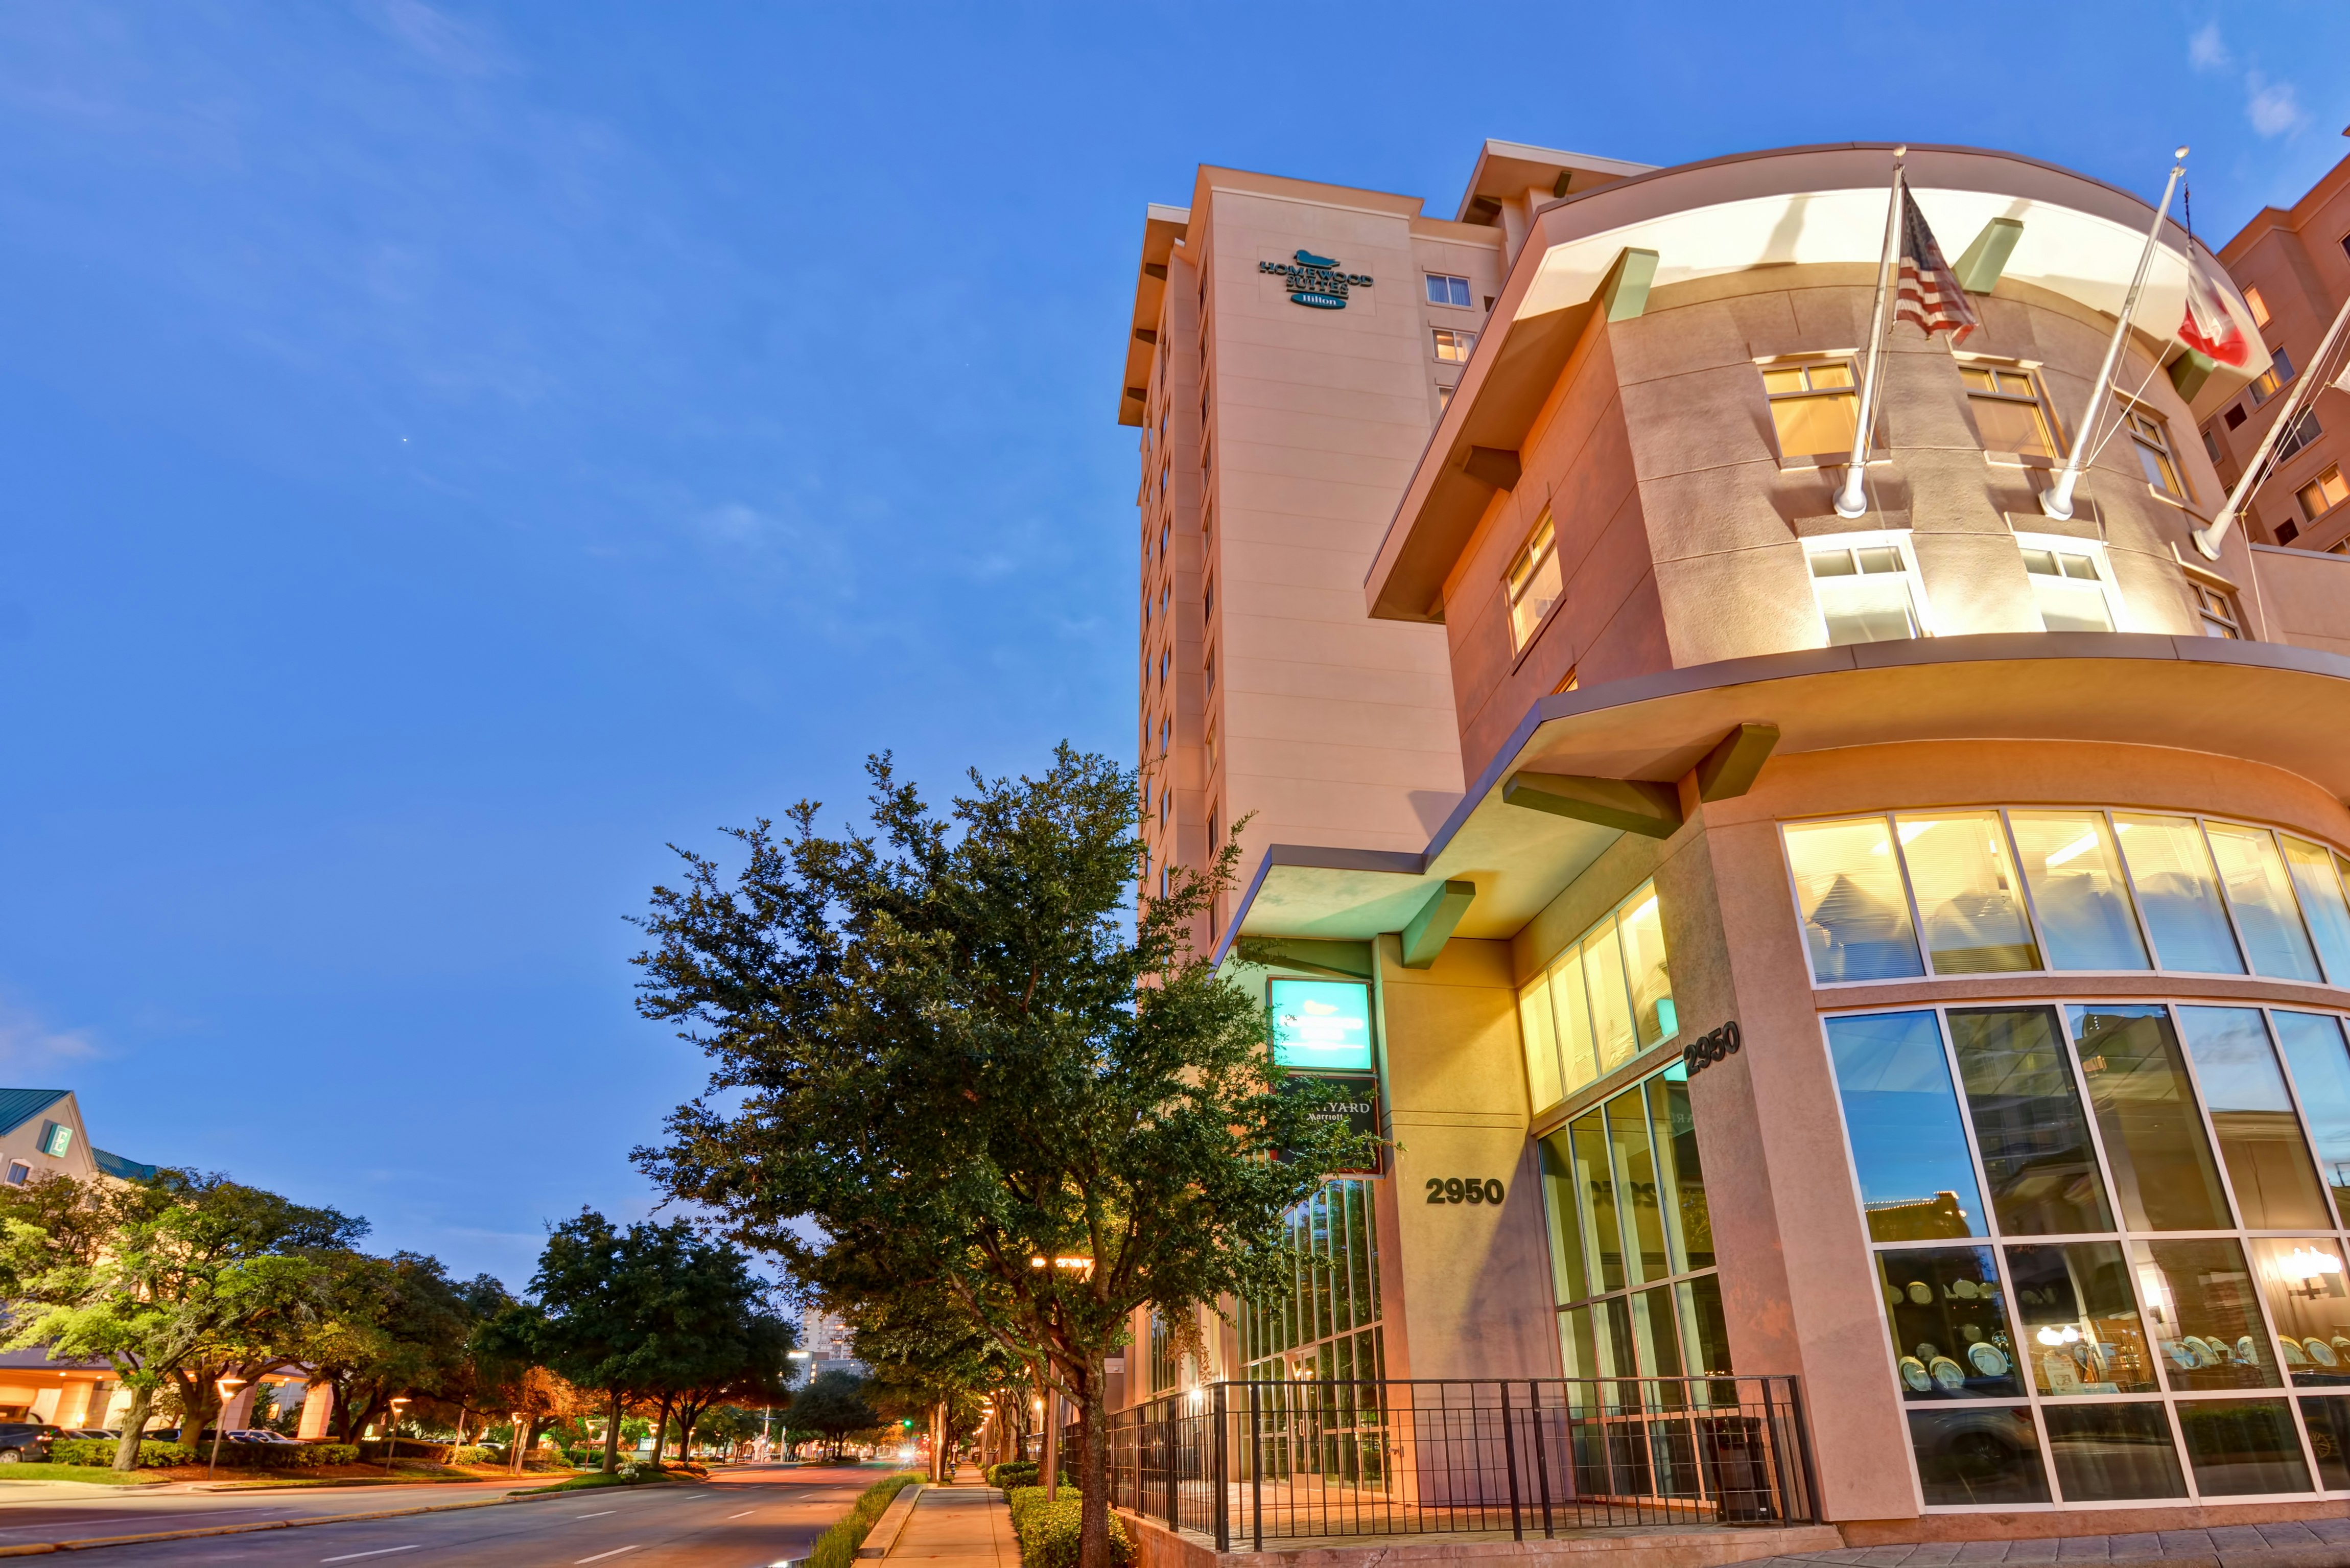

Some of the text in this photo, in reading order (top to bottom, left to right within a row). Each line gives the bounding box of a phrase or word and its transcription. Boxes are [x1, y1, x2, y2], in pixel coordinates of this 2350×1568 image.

[1259, 261, 1374, 287] HOMEWOOD
[1286, 275, 1349, 295] SUITES
[1302, 294, 1336, 306] Hilton
[1683, 1021, 1740, 1078] 2950
[1306, 1113, 1343, 1121] Marriott
[1426, 1178, 1505, 1204] 2950
